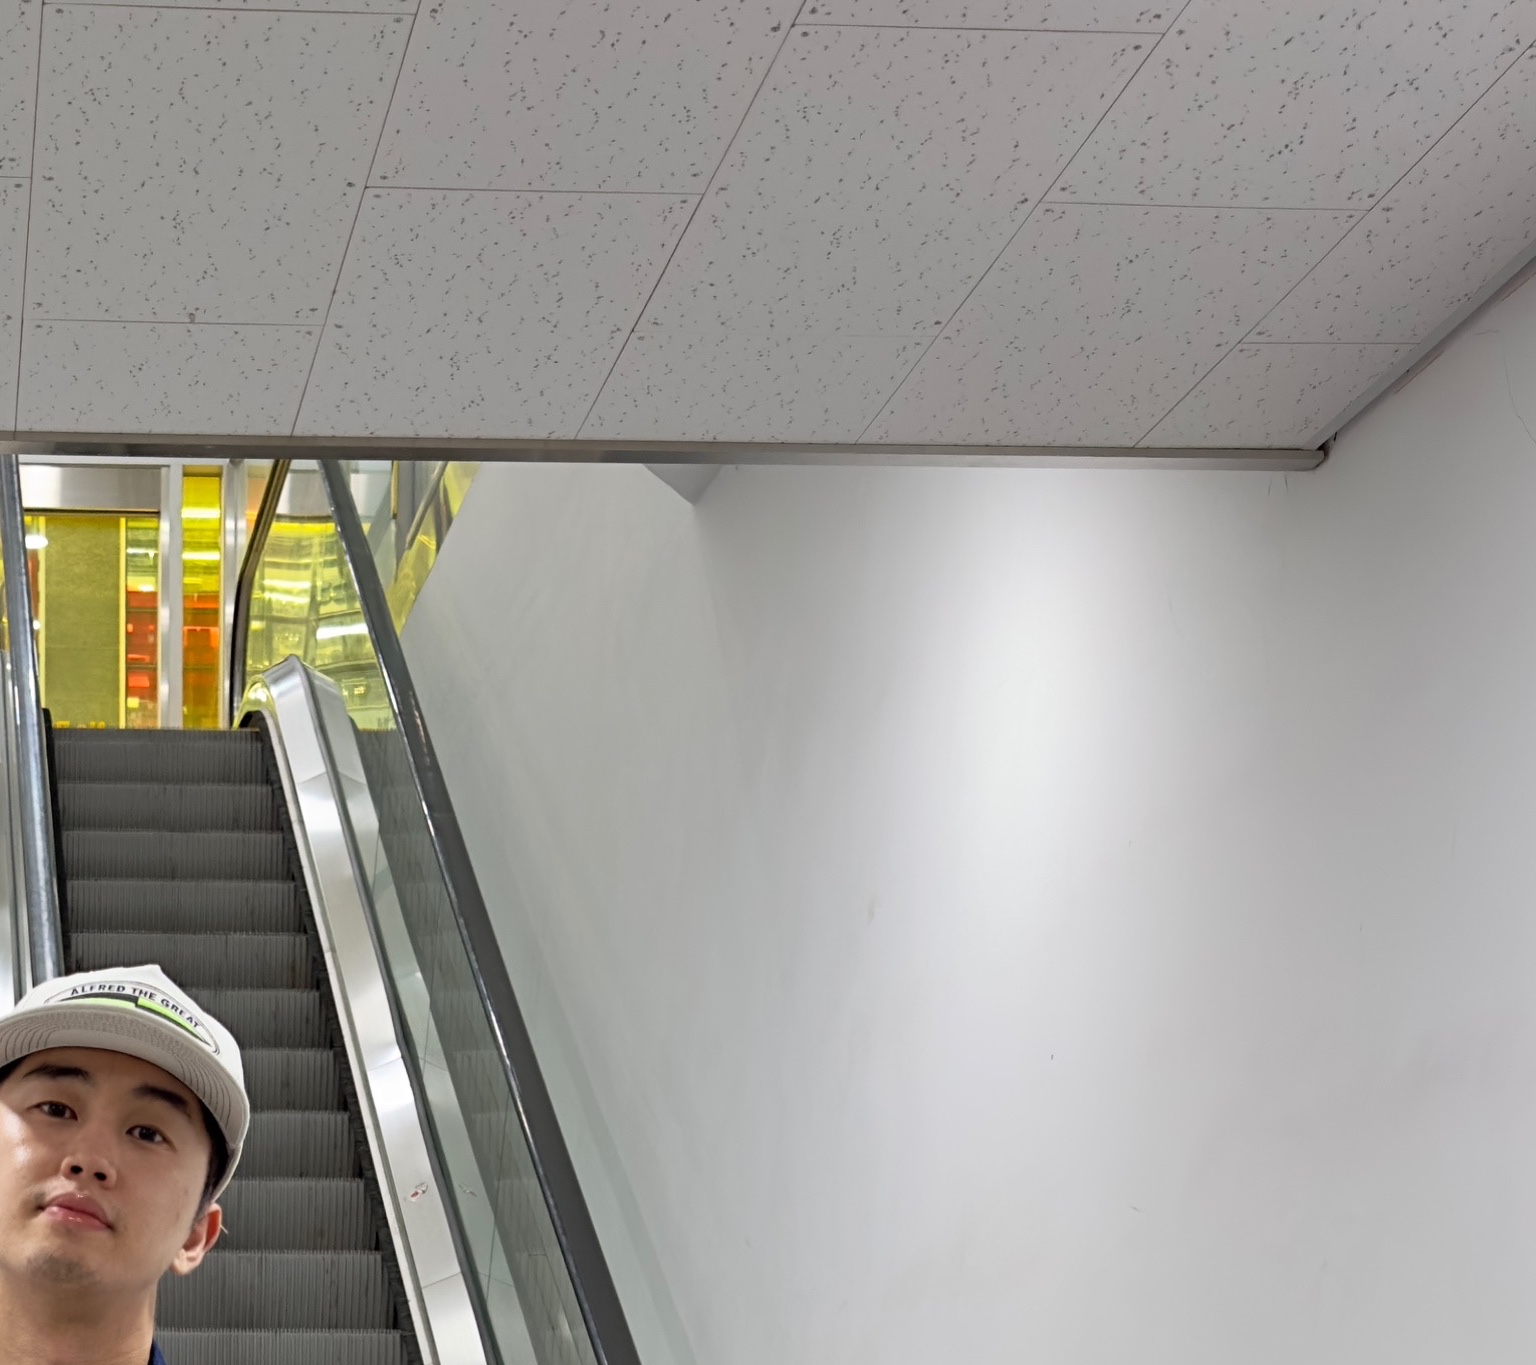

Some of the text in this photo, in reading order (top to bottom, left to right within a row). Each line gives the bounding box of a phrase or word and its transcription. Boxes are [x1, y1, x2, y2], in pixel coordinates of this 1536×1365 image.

[71, 984, 201, 1029] ALFRED THE GREAT
